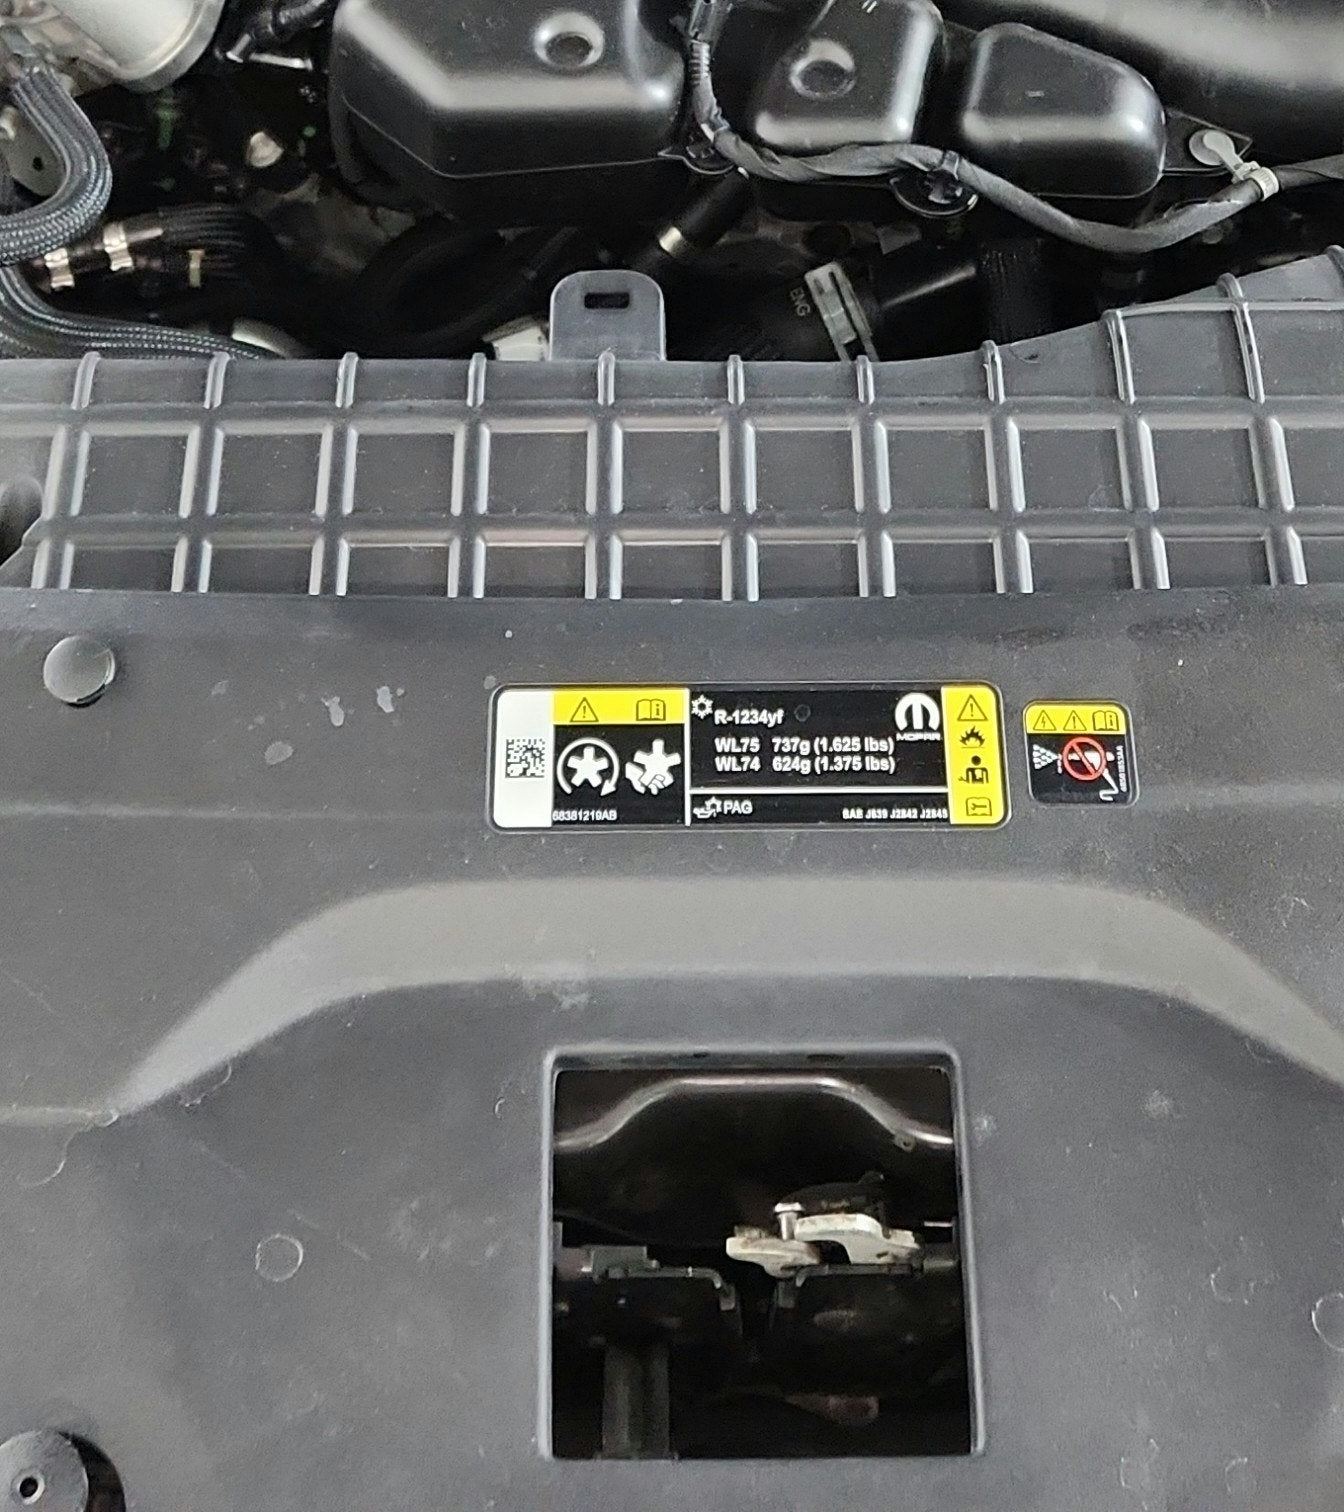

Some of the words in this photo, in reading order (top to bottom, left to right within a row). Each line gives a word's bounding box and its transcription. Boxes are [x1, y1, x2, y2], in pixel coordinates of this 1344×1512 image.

[714, 709, 784, 728] R-1234yf
[714, 737, 760, 753] WL75
[772, 738, 811, 756] 737g
[814, 737, 862, 756] (1.625
[864, 736, 895, 755] lbs)
[896, 732, 941, 741] MOPAR
[714, 756, 761, 772] WL74
[772, 756, 811, 775] 624g
[814, 756, 862, 775] (1.375
[865, 755, 896, 775] lbs)
[723, 800, 753, 815] PAG
